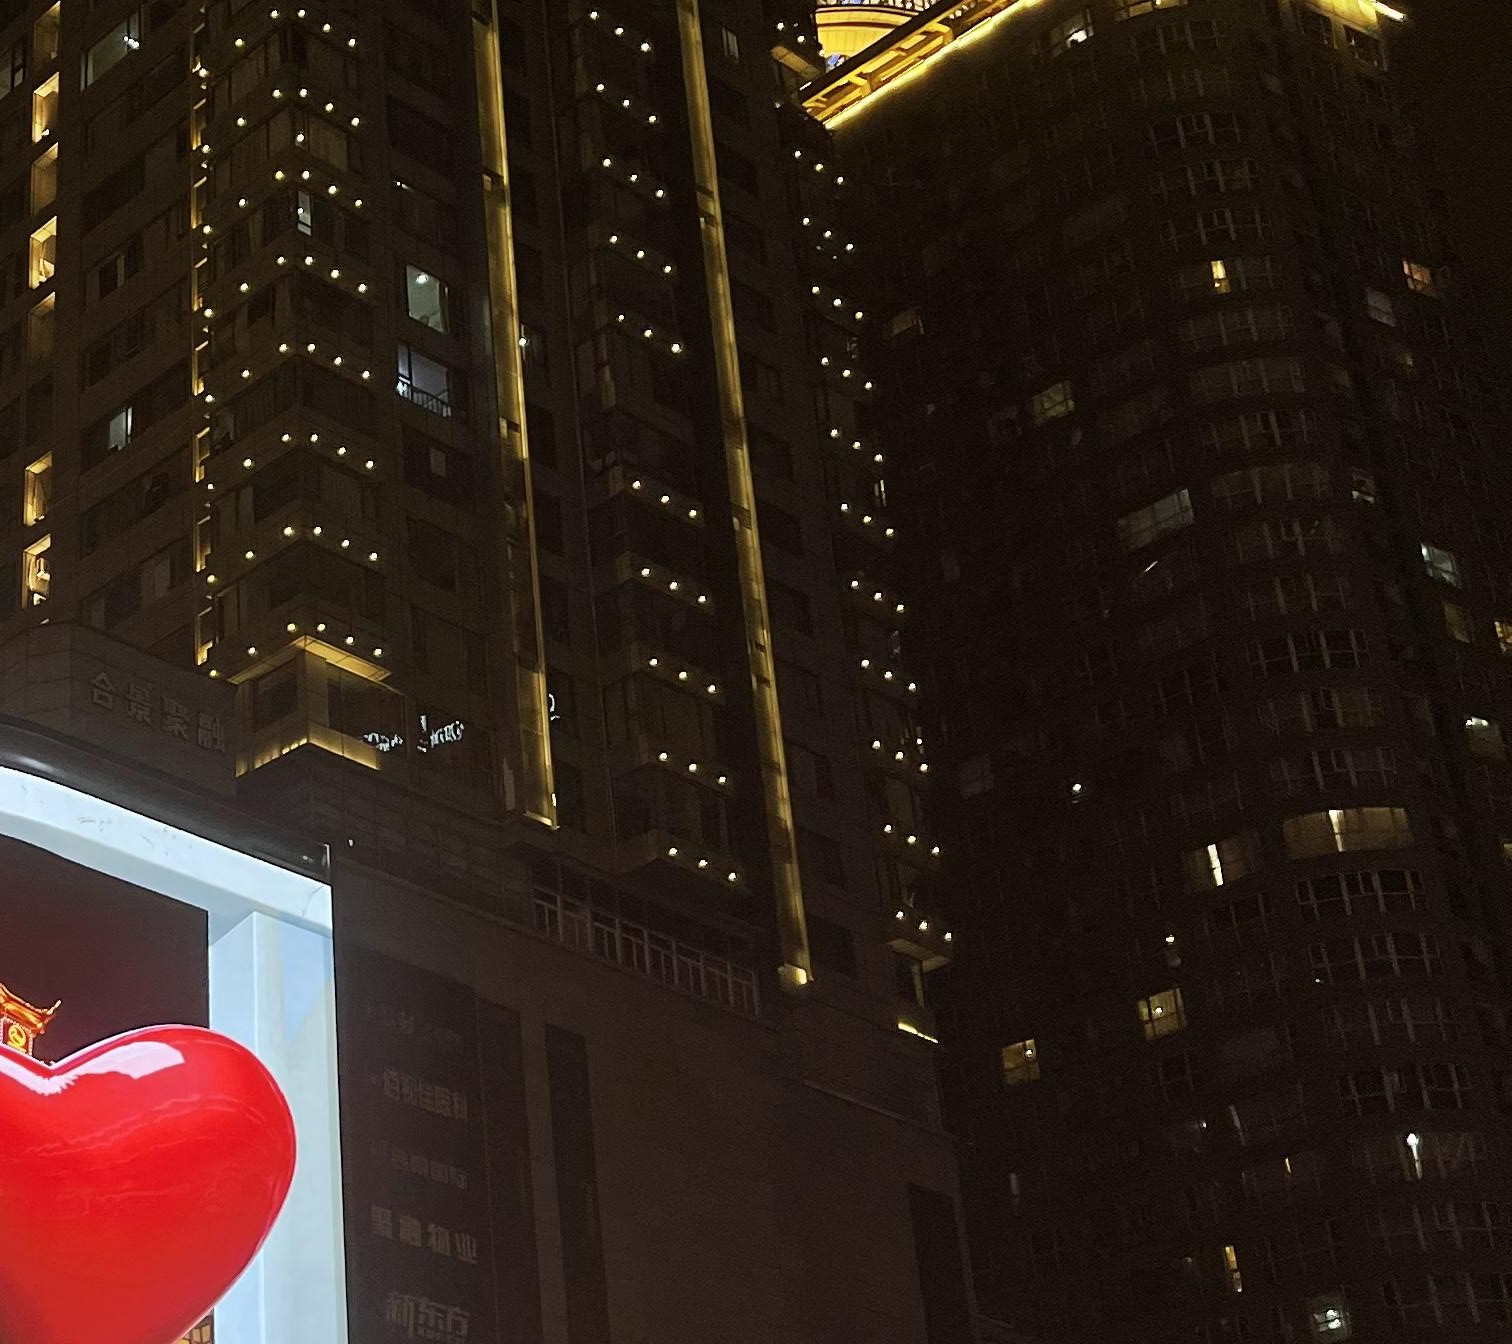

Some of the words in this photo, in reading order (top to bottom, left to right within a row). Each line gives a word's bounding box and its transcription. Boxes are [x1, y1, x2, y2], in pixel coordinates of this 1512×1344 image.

[89, 671, 226, 753] 合景聚融
[384, 1290, 471, 1339] 新东方
